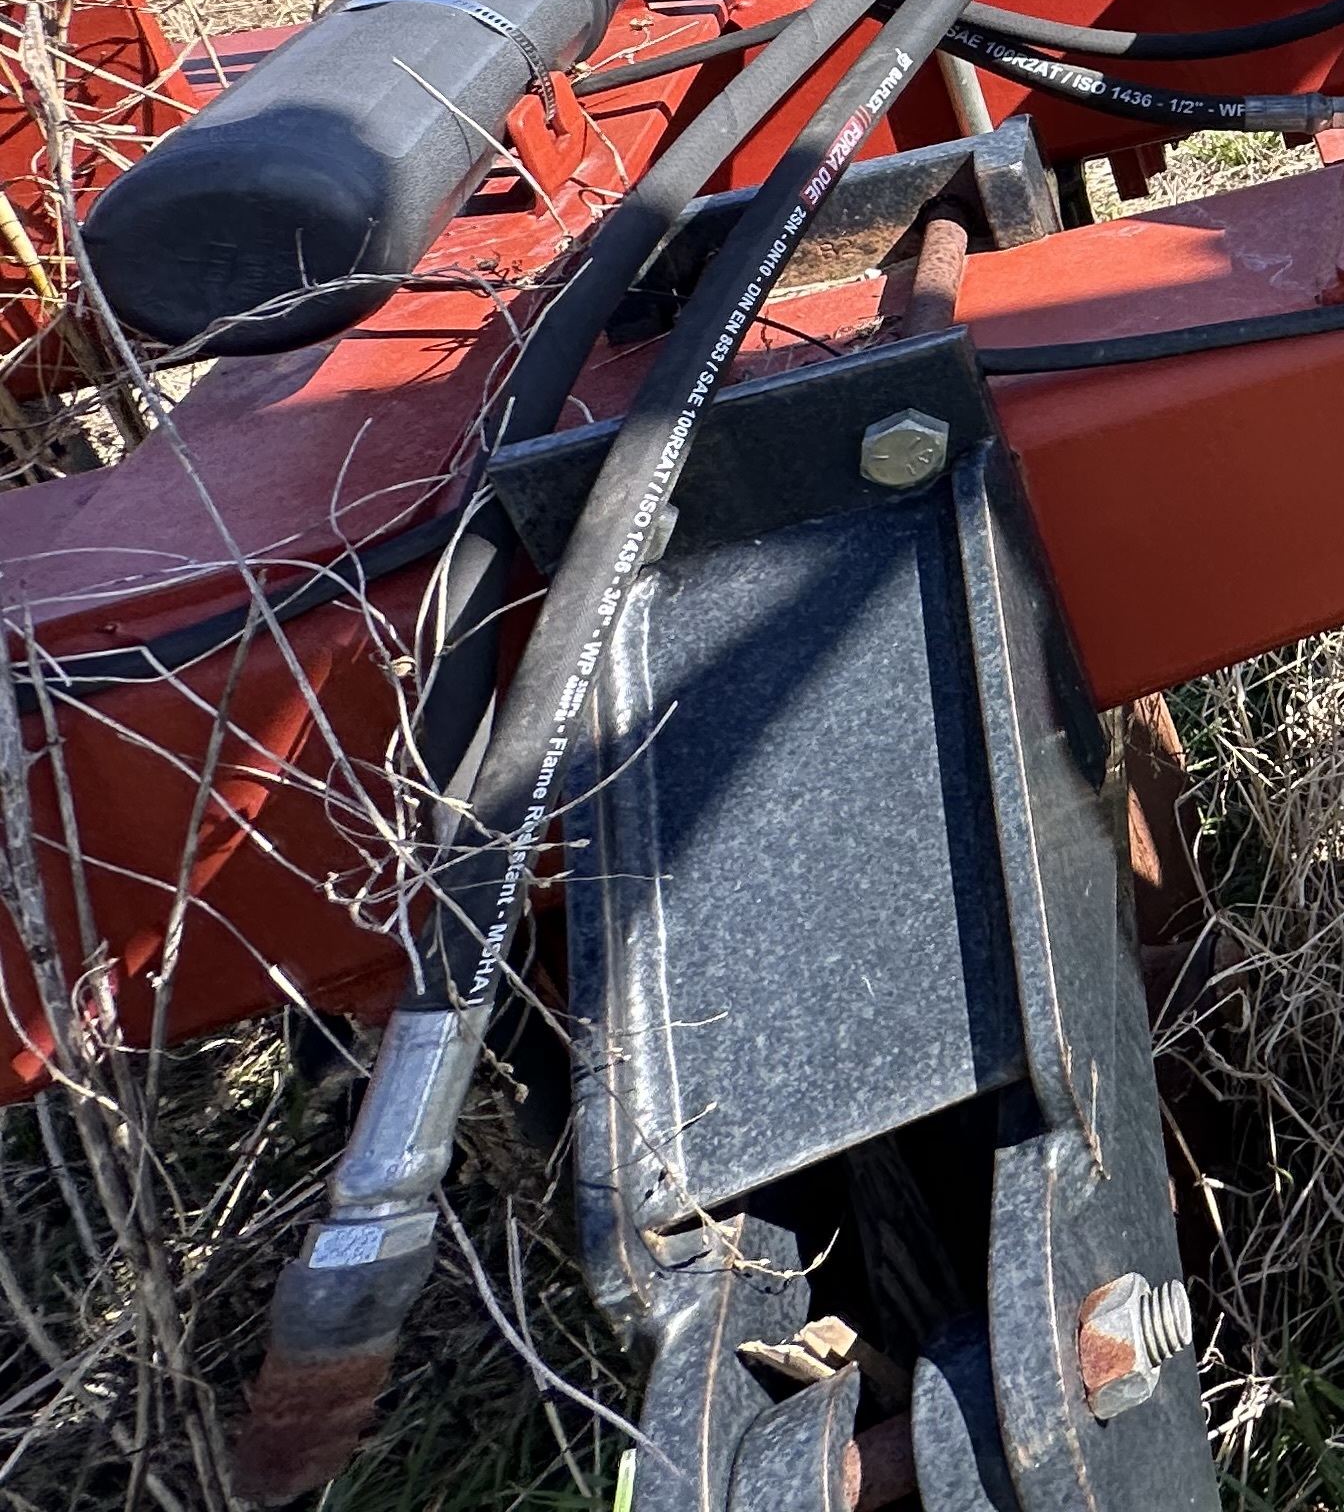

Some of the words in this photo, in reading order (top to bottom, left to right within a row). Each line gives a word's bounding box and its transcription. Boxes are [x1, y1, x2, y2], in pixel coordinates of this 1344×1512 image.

[985, 42, 1064, 80] 100R2AT
[1072, 74, 1107, 95] ISO
[1111, 87, 1153, 108] 1436
[826, 120, 864, 171] FORZA
[803, 166, 832, 205] DUE
[784, 205, 807, 235] 2SN
[758, 239, 788, 277] DN10
[738, 282, 762, 311] DIN
[725, 310, 746, 334] EN
[710, 333, 734, 362] 853
[687, 371, 715, 407] SAE
[653, 409, 696, 484] 100R2AT
[634, 493, 660, 528] ISO
[614, 531, 644, 574] 1436
[577, 641, 602, 676] WP
[533, 737, 569, 800] Flame
